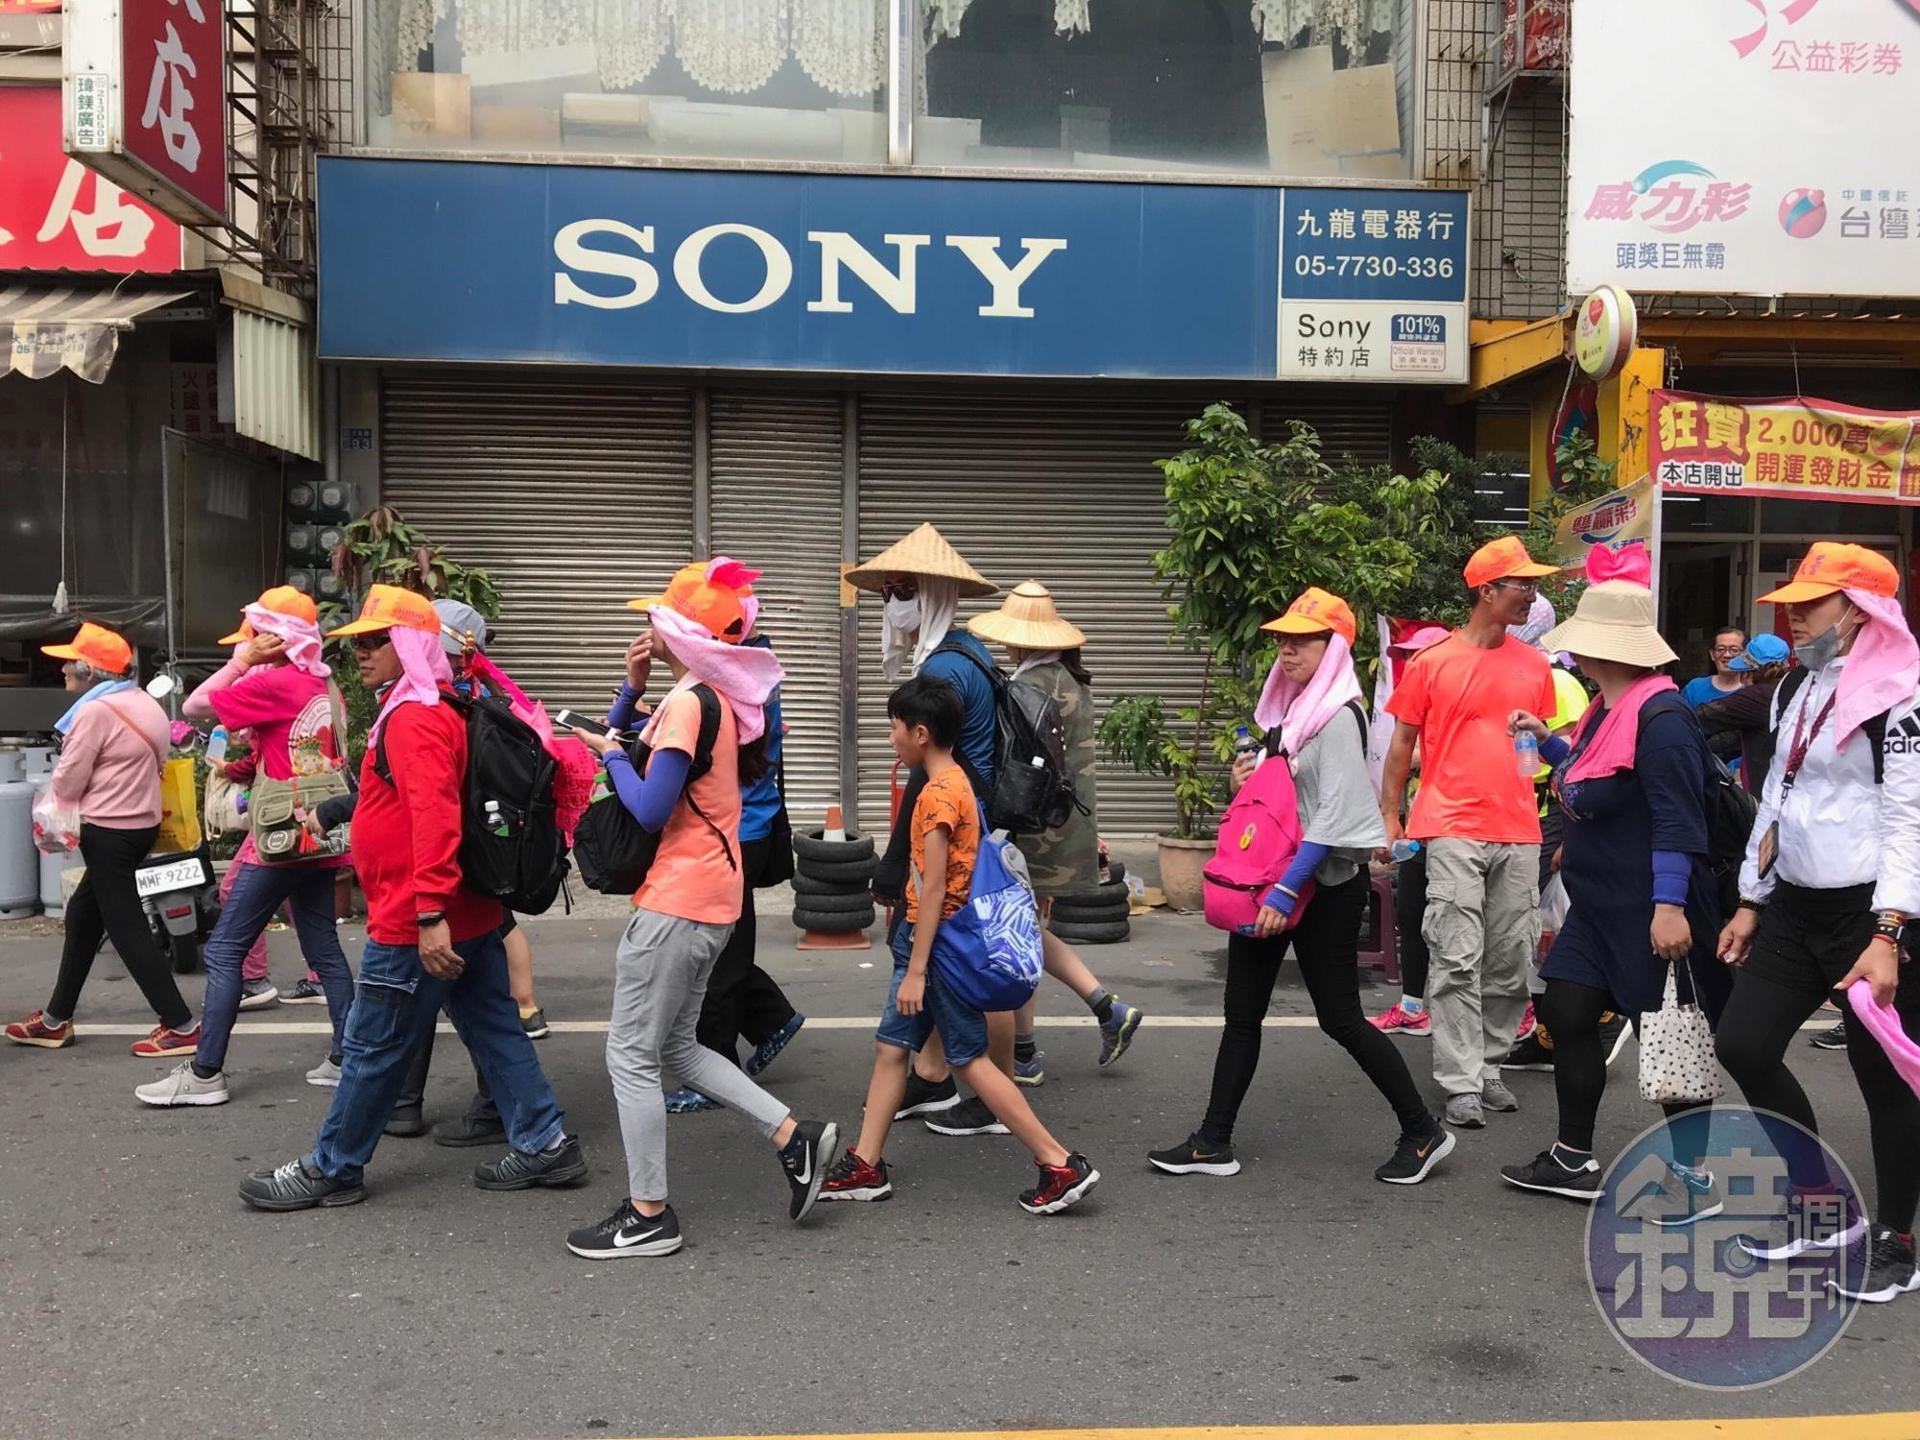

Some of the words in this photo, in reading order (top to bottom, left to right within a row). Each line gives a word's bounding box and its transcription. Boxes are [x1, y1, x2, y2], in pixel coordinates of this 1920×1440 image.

[1771, 39, 1903, 75] 公益彩券
[142, 0, 206, 173] 店
[0, 158, 155, 257] 店
[1584, 181, 1752, 222] 威力彩
[1296, 208, 1455, 240] 九龍電器行
[1840, 206, 1920, 239] 台灣
[553, 218, 1068, 318] SONY
[1295, 255, 1454, 278] 05-7730-336
[1616, 242, 1726, 270] 頭獎巨無霸
[1298, 313, 1371, 344] Sony
[1397, 316, 1441, 334] 101%
[1298, 346, 1371, 368] 特約店
[1658, 400, 1745, 456] 狂賀
[1757, 417, 1874, 454] 2,000萬
[1662, 462, 1743, 487] 本店開出
[1756, 452, 1893, 489] 開運發財金
